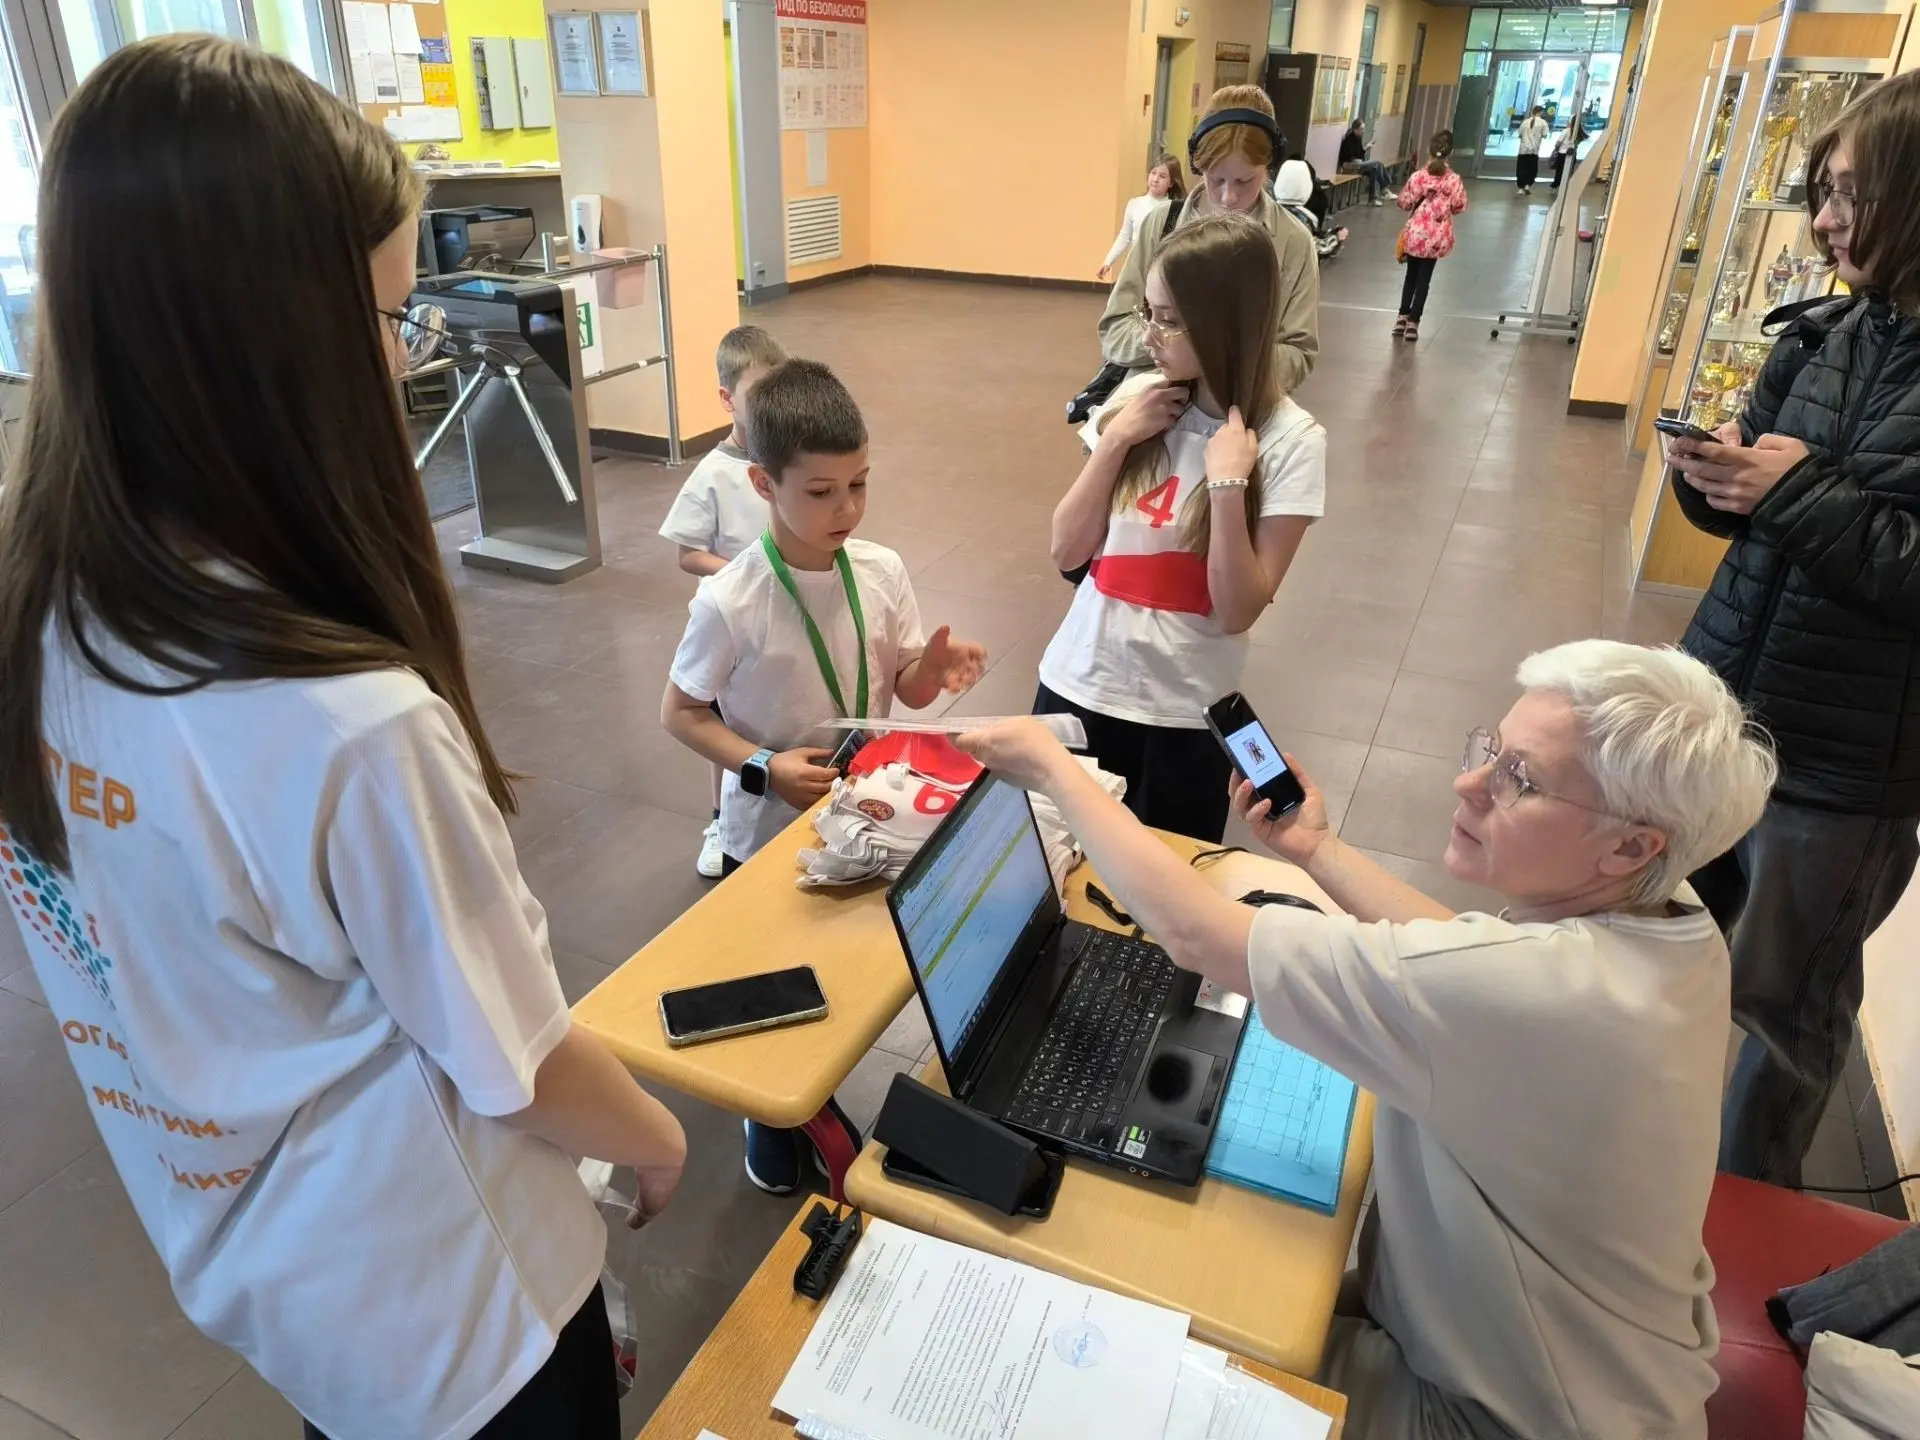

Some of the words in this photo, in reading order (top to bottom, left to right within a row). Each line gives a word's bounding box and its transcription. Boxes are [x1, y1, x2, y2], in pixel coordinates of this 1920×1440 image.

[796, 0, 808, 13] ПО
[809, 0, 865, 19] БЕЗОПАСНОСТИ
[1136, 475, 1180, 528] 4
